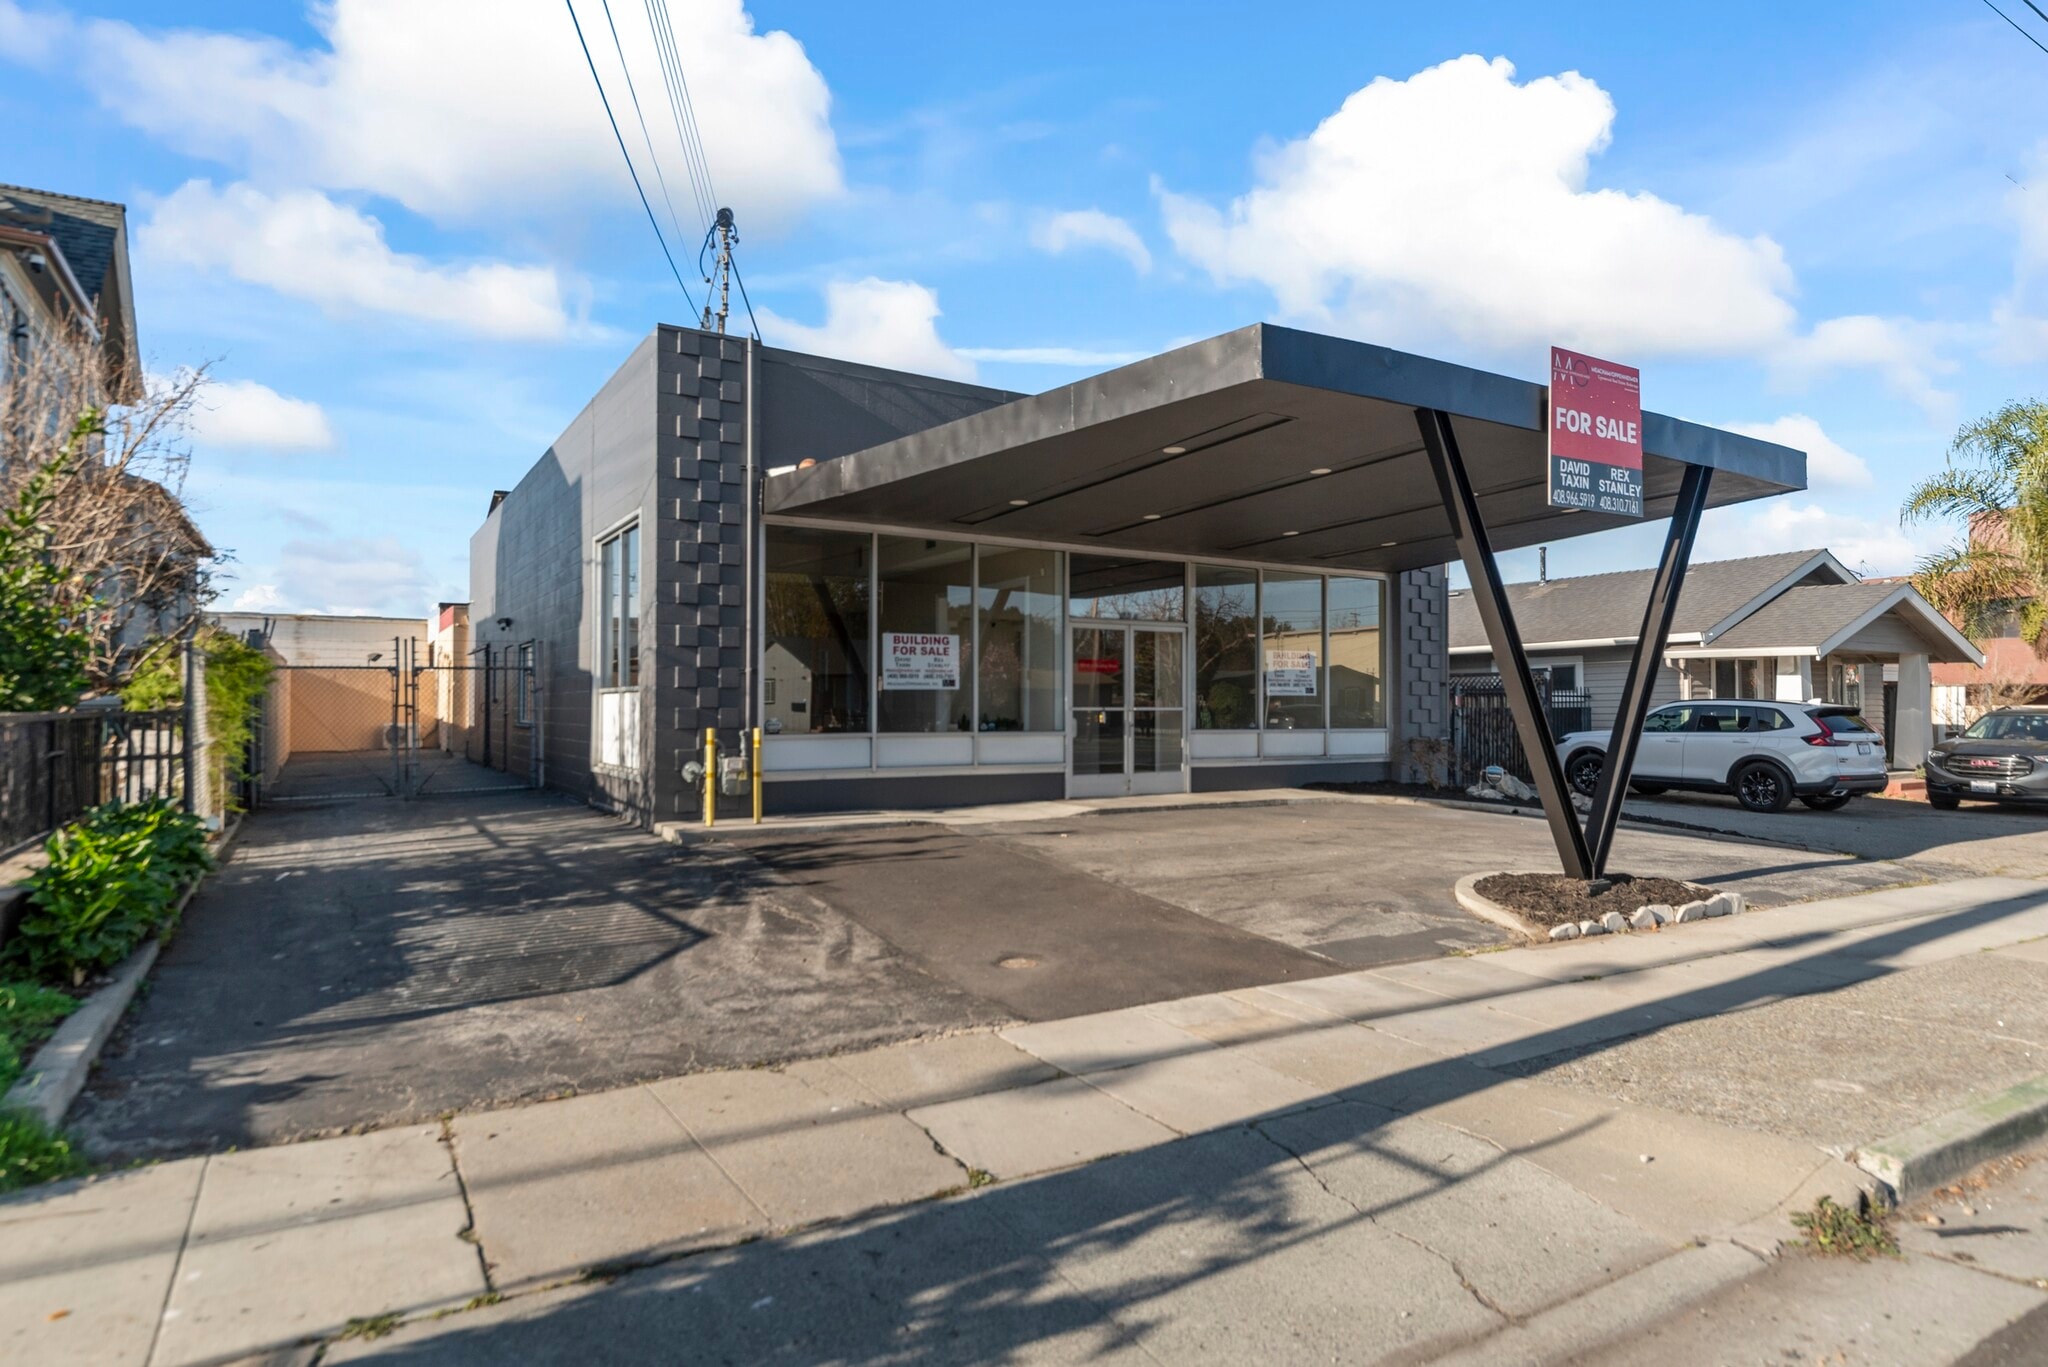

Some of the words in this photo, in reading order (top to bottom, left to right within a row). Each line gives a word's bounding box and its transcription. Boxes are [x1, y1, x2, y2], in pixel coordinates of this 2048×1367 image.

[1556, 406, 1592, 435] FOR
[1596, 415, 1638, 444] SALE
[1560, 459, 1591, 476] DAVID
[1610, 468, 1630, 483] REX
[1560, 473, 1590, 490] TAXIN
[1598, 479, 1642, 498] STANLEY
[1552, 489, 1596, 508] 408.966.5919
[1599, 496, 1639, 514] 408.310.7161
[893, 635, 950, 645] BUILDING
[892, 646, 917, 655] FOR
[920, 646, 950, 656] SALE
[1272, 660, 1289, 668] FOR
[1290, 661, 1311, 669] SALE
[1970, 759, 2000, 768] GMC
